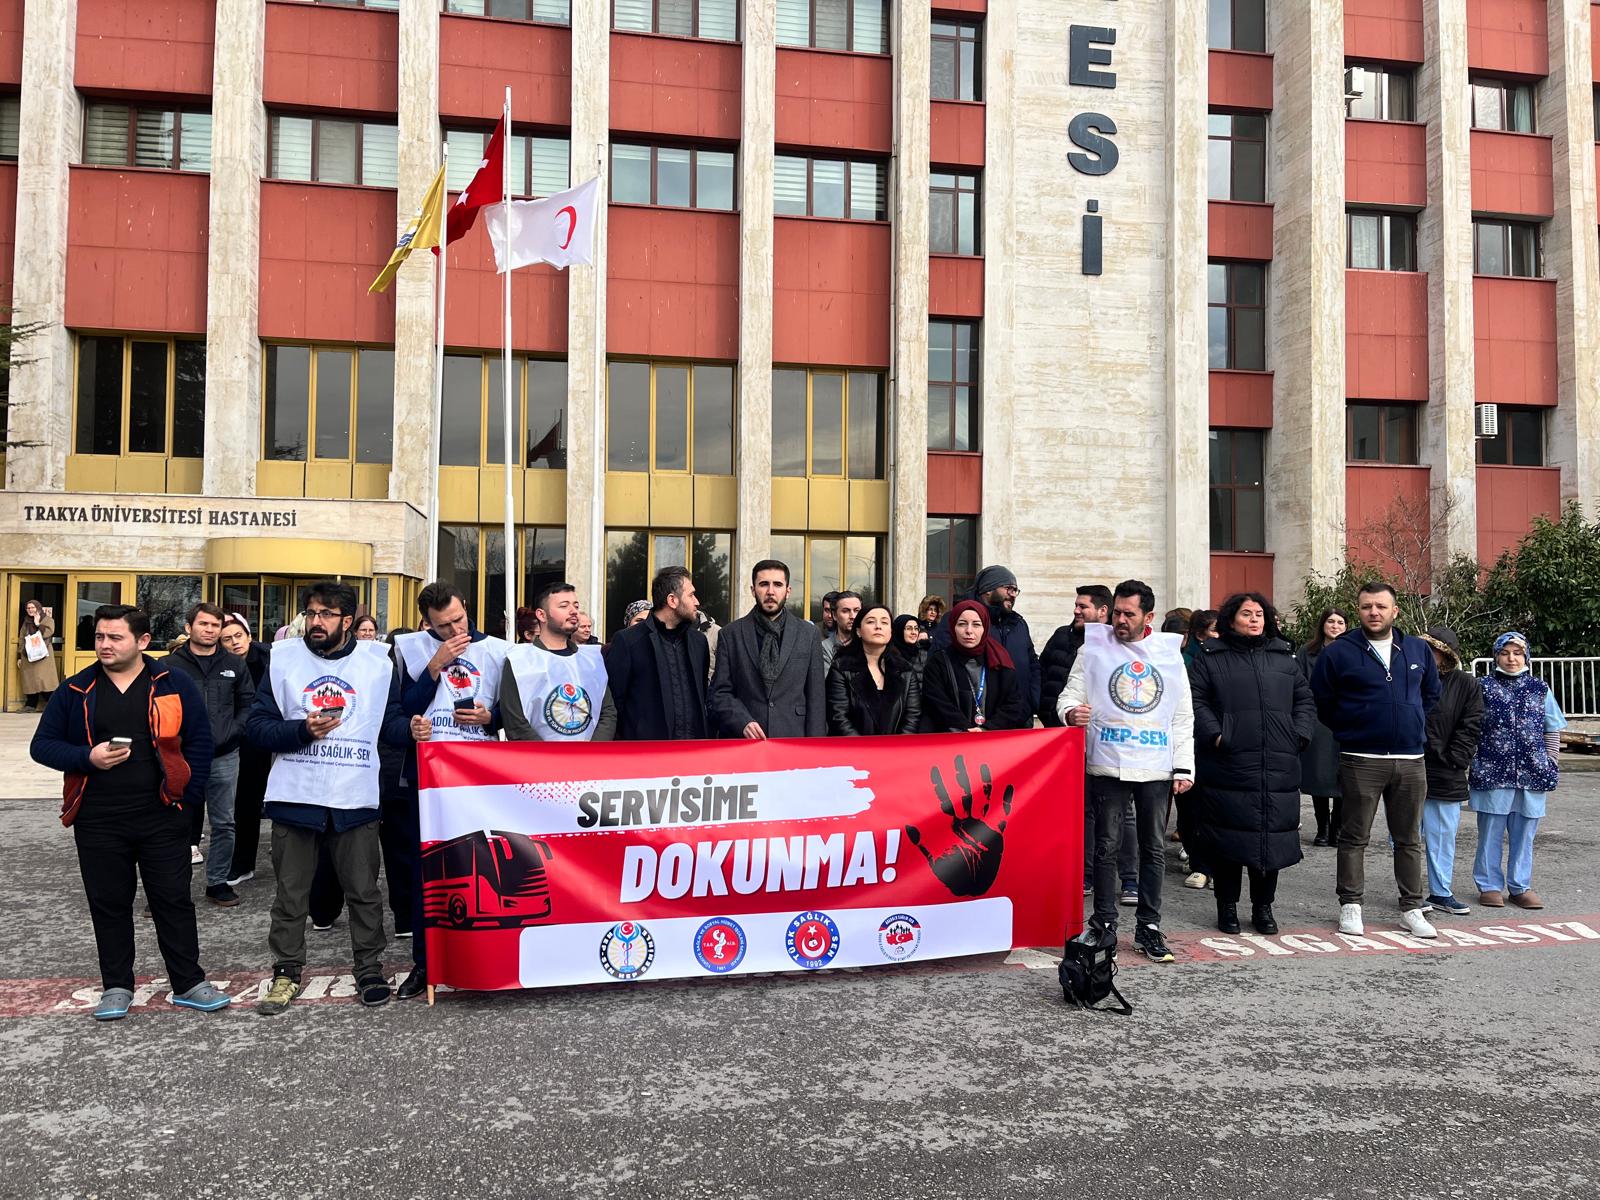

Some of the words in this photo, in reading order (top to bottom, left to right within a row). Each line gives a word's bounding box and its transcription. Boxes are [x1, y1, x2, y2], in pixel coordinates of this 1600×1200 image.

[1066, 0, 1120, 276] ESİ
[24, 505, 89, 522] TRAKYA
[91, 504, 203, 525] ÜNİVERSİTESİ
[208, 509, 298, 527] HASTANESİ
[1100, 727, 1168, 746] HEP-SEN
[577, 776, 759, 829] SERVİSİME
[620, 829, 901, 904] DOKUNMA!
[788, 930, 800, 961] TÜRK
